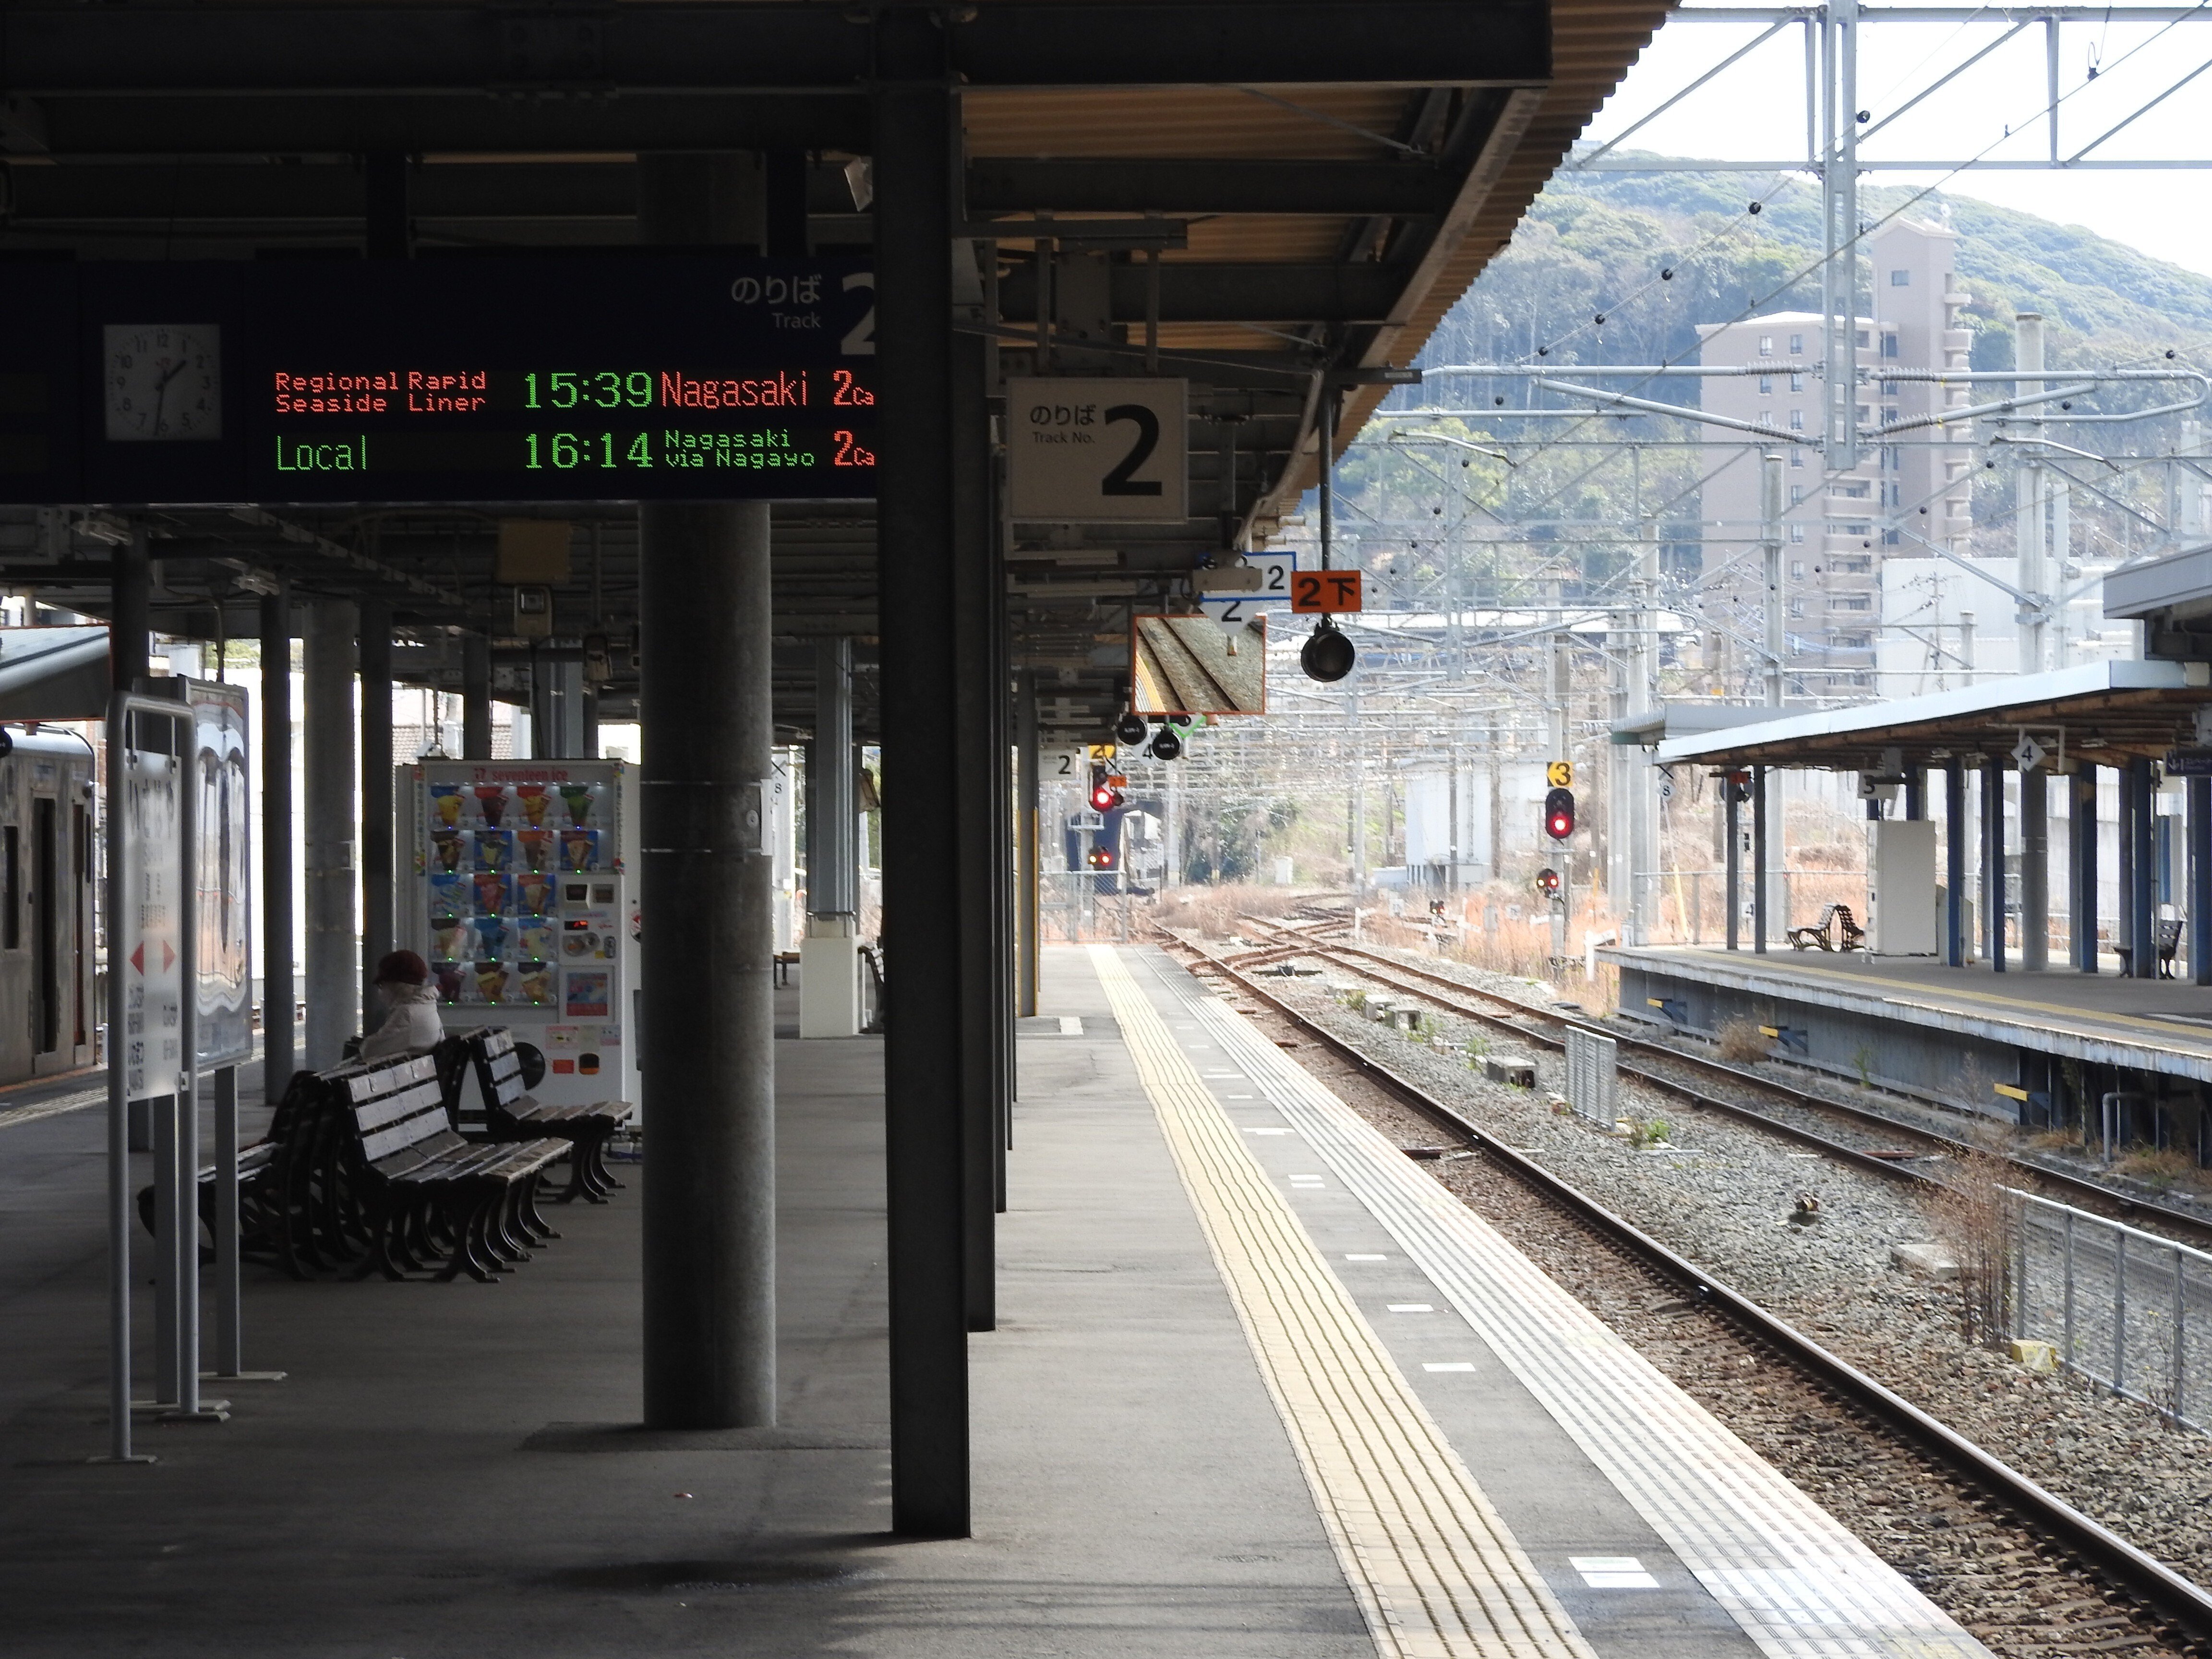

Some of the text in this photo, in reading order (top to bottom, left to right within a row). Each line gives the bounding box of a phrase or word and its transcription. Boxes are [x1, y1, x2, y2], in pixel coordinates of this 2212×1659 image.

[731, 274, 822, 304] のりば
[772, 311, 821, 329] Track
[841, 272, 876, 355] 2
[276, 372, 487, 394] Regional Rapid
[525, 372, 653, 409] 15:39
[661, 371, 808, 410] Nagasaki
[276, 394, 486, 413] Seaside Liner
[1030, 404, 1096, 426] のりば
[665, 430, 791, 451] Nagasaki
[1033, 430, 1095, 445] Track No.
[277, 435, 367, 471] Local
[526, 433, 653, 469] 16:14
[665, 449, 816, 469] via Nagayo
[1101, 404, 1163, 496] 2
[1268, 565, 1285, 590] 2
[1298, 577, 1356, 606] 2下
[1058, 755, 1071, 774] 2
[2021, 745, 2033, 762] 4
[492, 769, 549, 782] seventeen
[1555, 762, 1571, 786] 3
